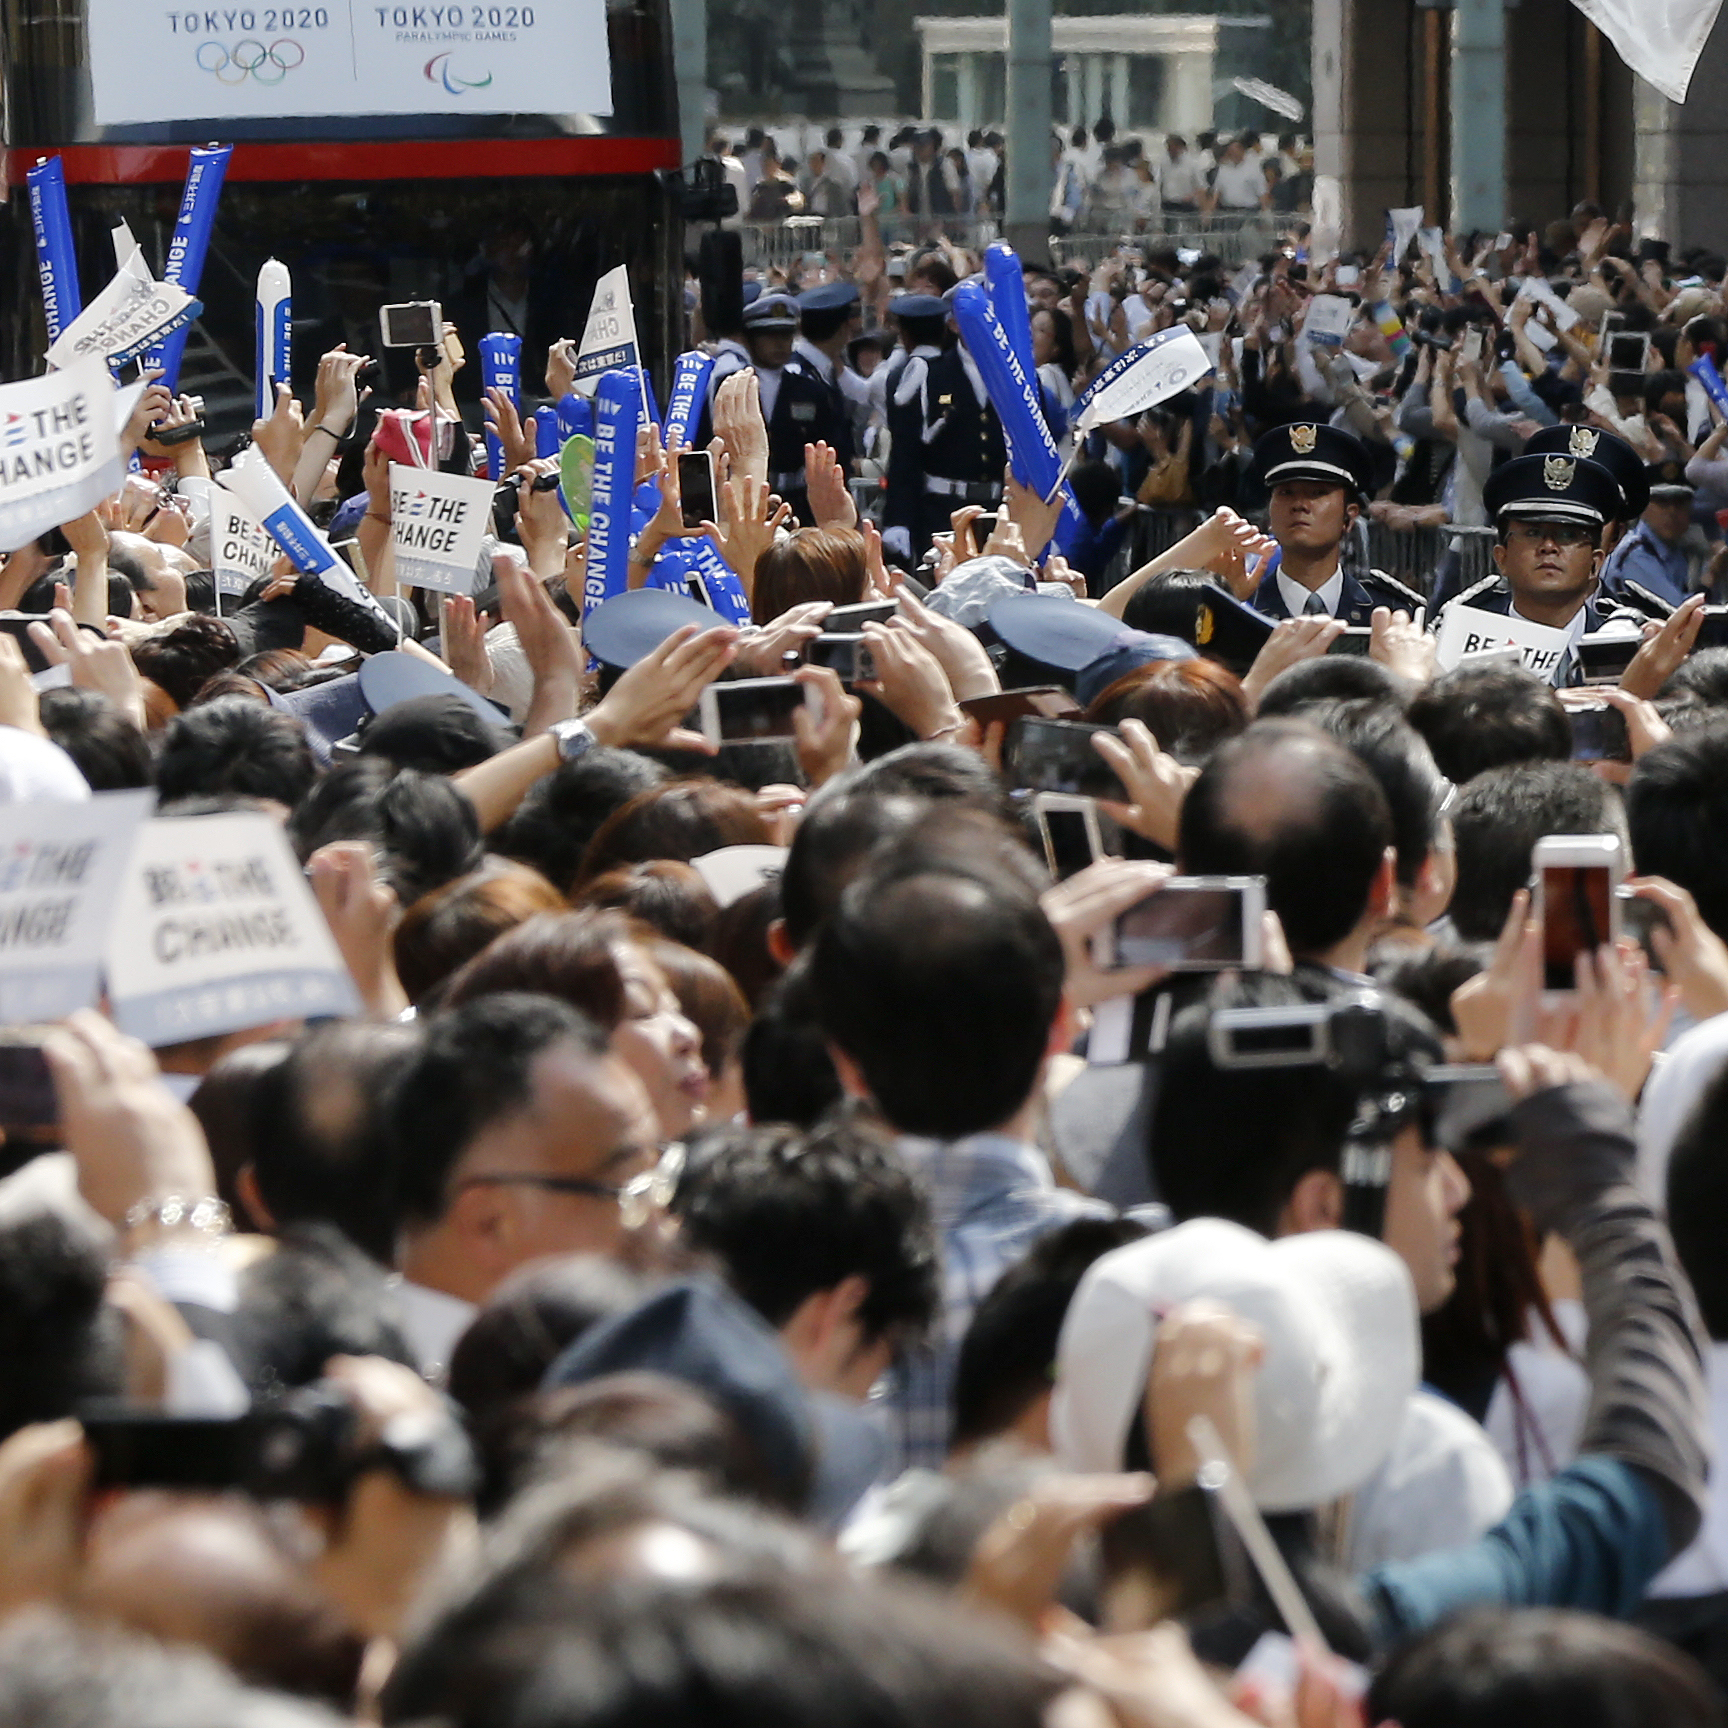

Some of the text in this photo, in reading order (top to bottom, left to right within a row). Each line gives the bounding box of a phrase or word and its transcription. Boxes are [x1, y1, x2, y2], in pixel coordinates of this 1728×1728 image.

[167, 7, 329, 33] TOKYO 2020
[375, 6, 534, 29] TOKYO 2020
[165, 235, 189, 290] ANGE
[677, 373, 698, 393] BE
[31, 392, 91, 438] THE
[670, 393, 693, 426] THE
[428, 497, 468, 524] THE
[584, 423, 616, 610] BE THE CHANGE
[228, 515, 285, 559] BE TH
[394, 521, 460, 553] HANGE
[223, 542, 271, 573] CHAN
[1464, 632, 1560, 670] BE THE
[142, 857, 277, 904] BE THE
[153, 907, 298, 964] CHANGE
